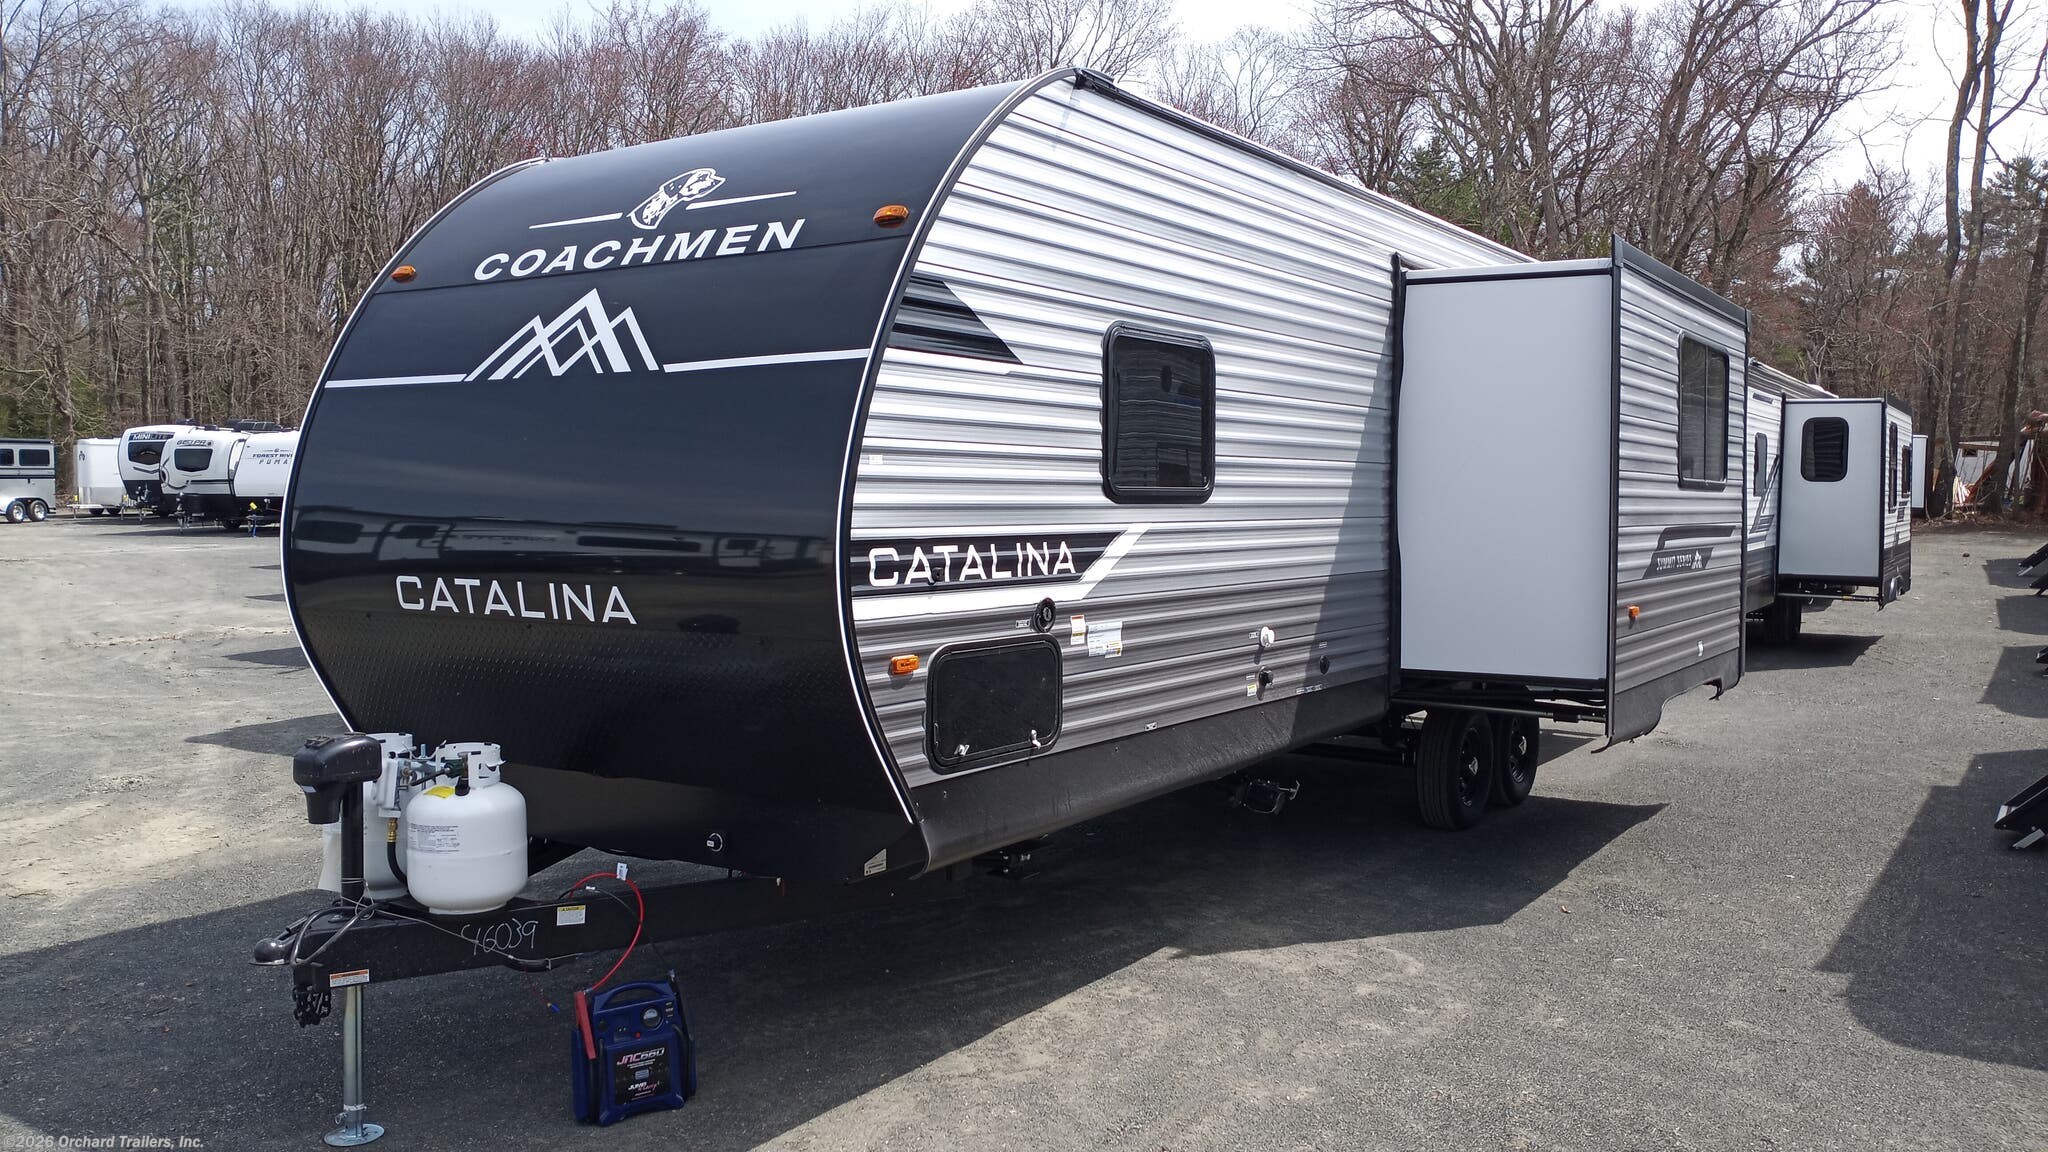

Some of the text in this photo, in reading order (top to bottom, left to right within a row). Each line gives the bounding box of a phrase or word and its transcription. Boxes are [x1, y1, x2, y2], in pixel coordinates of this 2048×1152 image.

[473, 218, 806, 281] COACHMEN
[868, 540, 1077, 587] CATALINA
[395, 575, 638, 625] CATALINA
